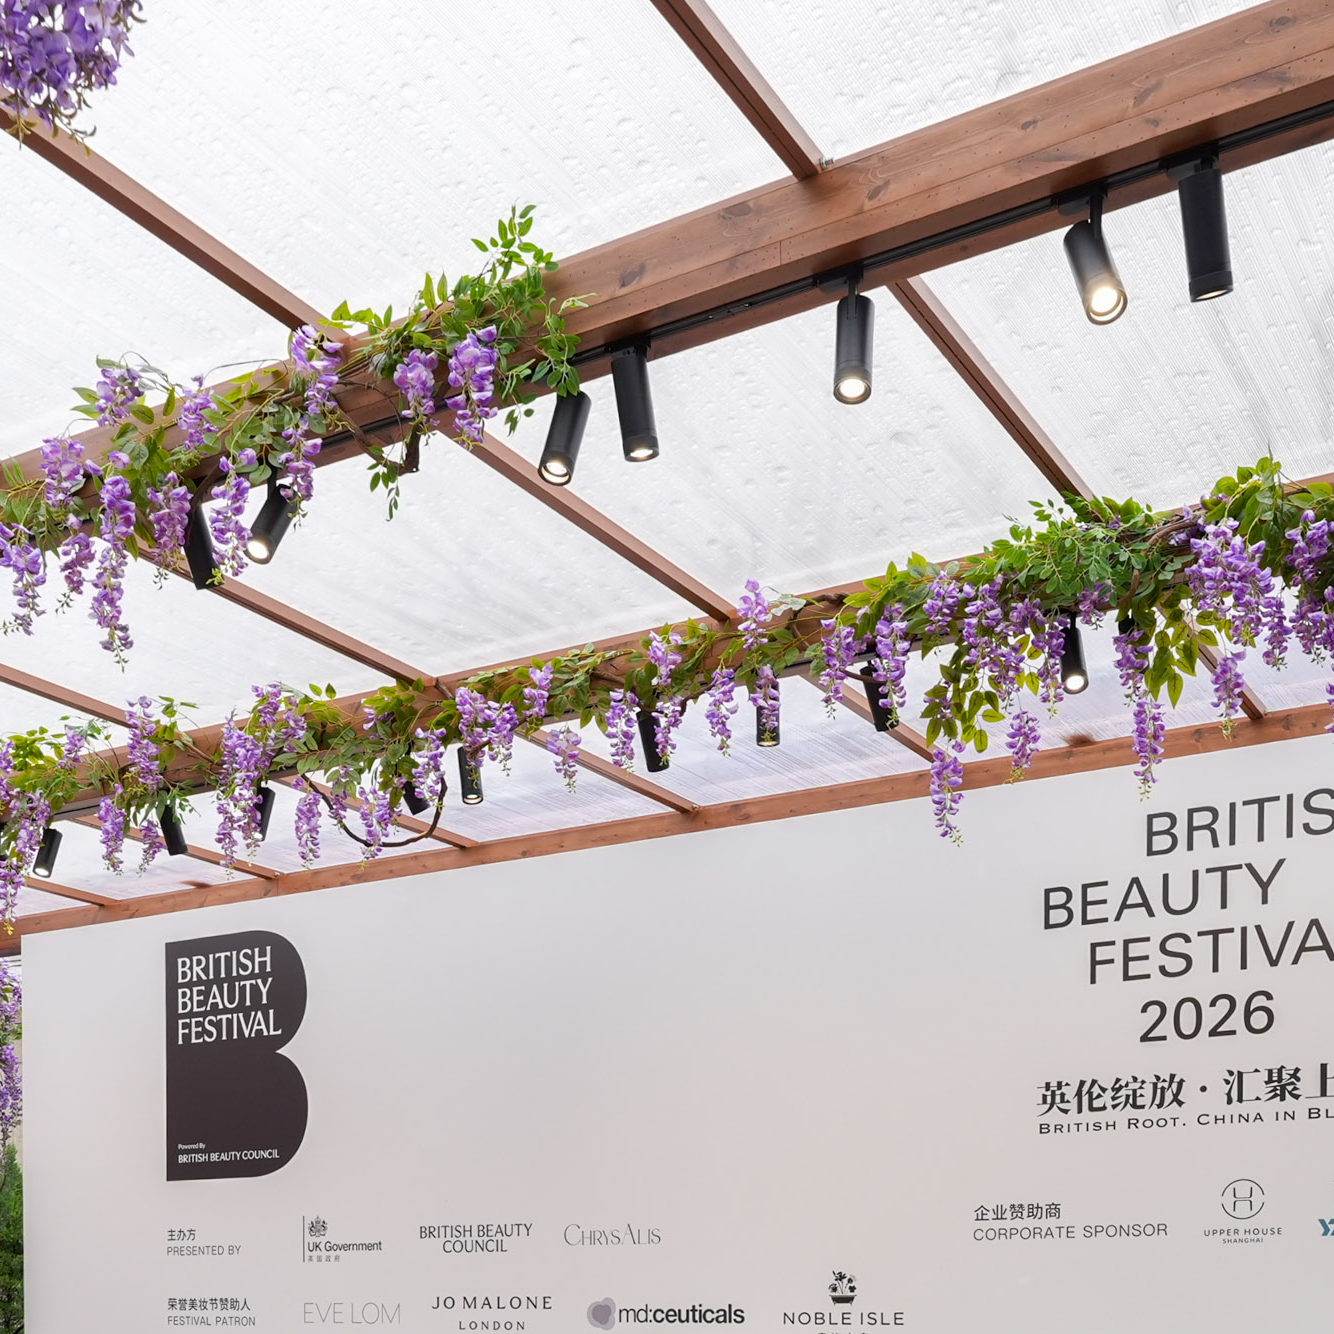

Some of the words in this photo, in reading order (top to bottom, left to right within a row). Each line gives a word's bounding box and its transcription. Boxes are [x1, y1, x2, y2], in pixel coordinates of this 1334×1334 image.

[1043, 857, 1287, 930] BEAUTY
[177, 945, 272, 983] BRITISH
[177, 978, 274, 1014] BEAUTY
[1139, 990, 1275, 1043] 2026
[178, 1009, 283, 1045] FESTIVAL
[197, 1143, 206, 1151] By
[177, 1153, 208, 1164] BRITISH
[210, 1151, 240, 1162] BEAUTY
[241, 1148, 280, 1161] COUNCIL
[974, 1202, 1062, 1222] 企业赞助商
[167, 1229, 196, 1242] 主办方
[419, 1224, 473, 1241] BRITISH
[476, 1223, 533, 1239] BEAUTY
[973, 1226, 1076, 1242] CORPORATE
[1082, 1223, 1168, 1239] SPONSOR
[1203, 1228, 1240, 1237] UPPER
[1243, 1227, 1282, 1237] HOUSE
[307, 1241, 323, 1252] UK
[324, 1240, 382, 1253] Government
[442, 1238, 508, 1254] COUNCIL
[1222, 1237, 1264, 1245] SHANGHAI
[167, 1245, 224, 1257] PRESENTED
[227, 1245, 242, 1256] BY
[307, 1254, 341, 1263] 英国政府
[167, 1297, 251, 1312] 荣誉美妆节赞助人
[431, 1296, 456, 1310] JO
[462, 1296, 552, 1310] MALONE
[167, 1315, 212, 1327] FESTIVAL
[215, 1315, 256, 1327] PATRON
[303, 1303, 345, 1324] EVE
[351, 1302, 401, 1325] LOM
[618, 1304, 745, 1325] md:ceuticals
[783, 1311, 852, 1326] NOBLE
[860, 1311, 905, 1326] ISLE
[458, 1320, 525, 1331] LONDON
